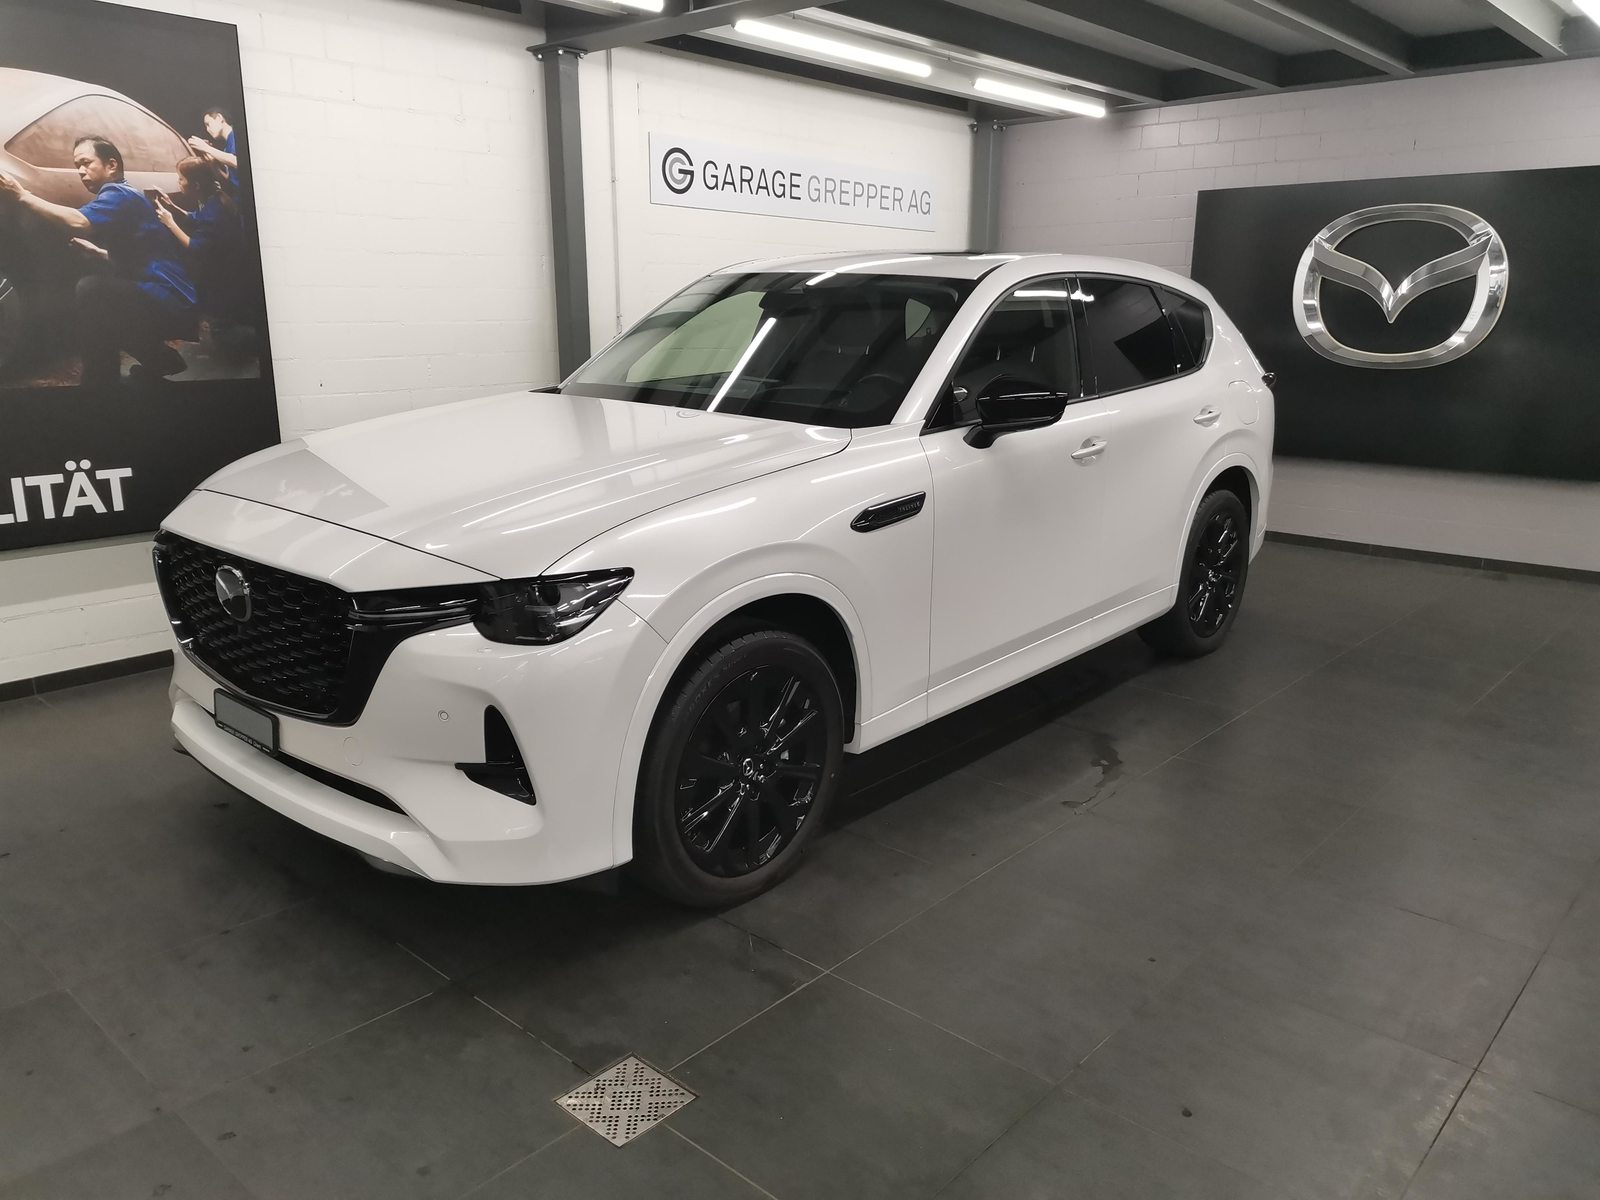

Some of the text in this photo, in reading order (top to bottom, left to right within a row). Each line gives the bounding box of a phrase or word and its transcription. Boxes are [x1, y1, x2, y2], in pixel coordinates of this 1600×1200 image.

[702, 160, 802, 201] GARAGE
[807, 175, 904, 212] GREPPER
[907, 189, 932, 216] AG
